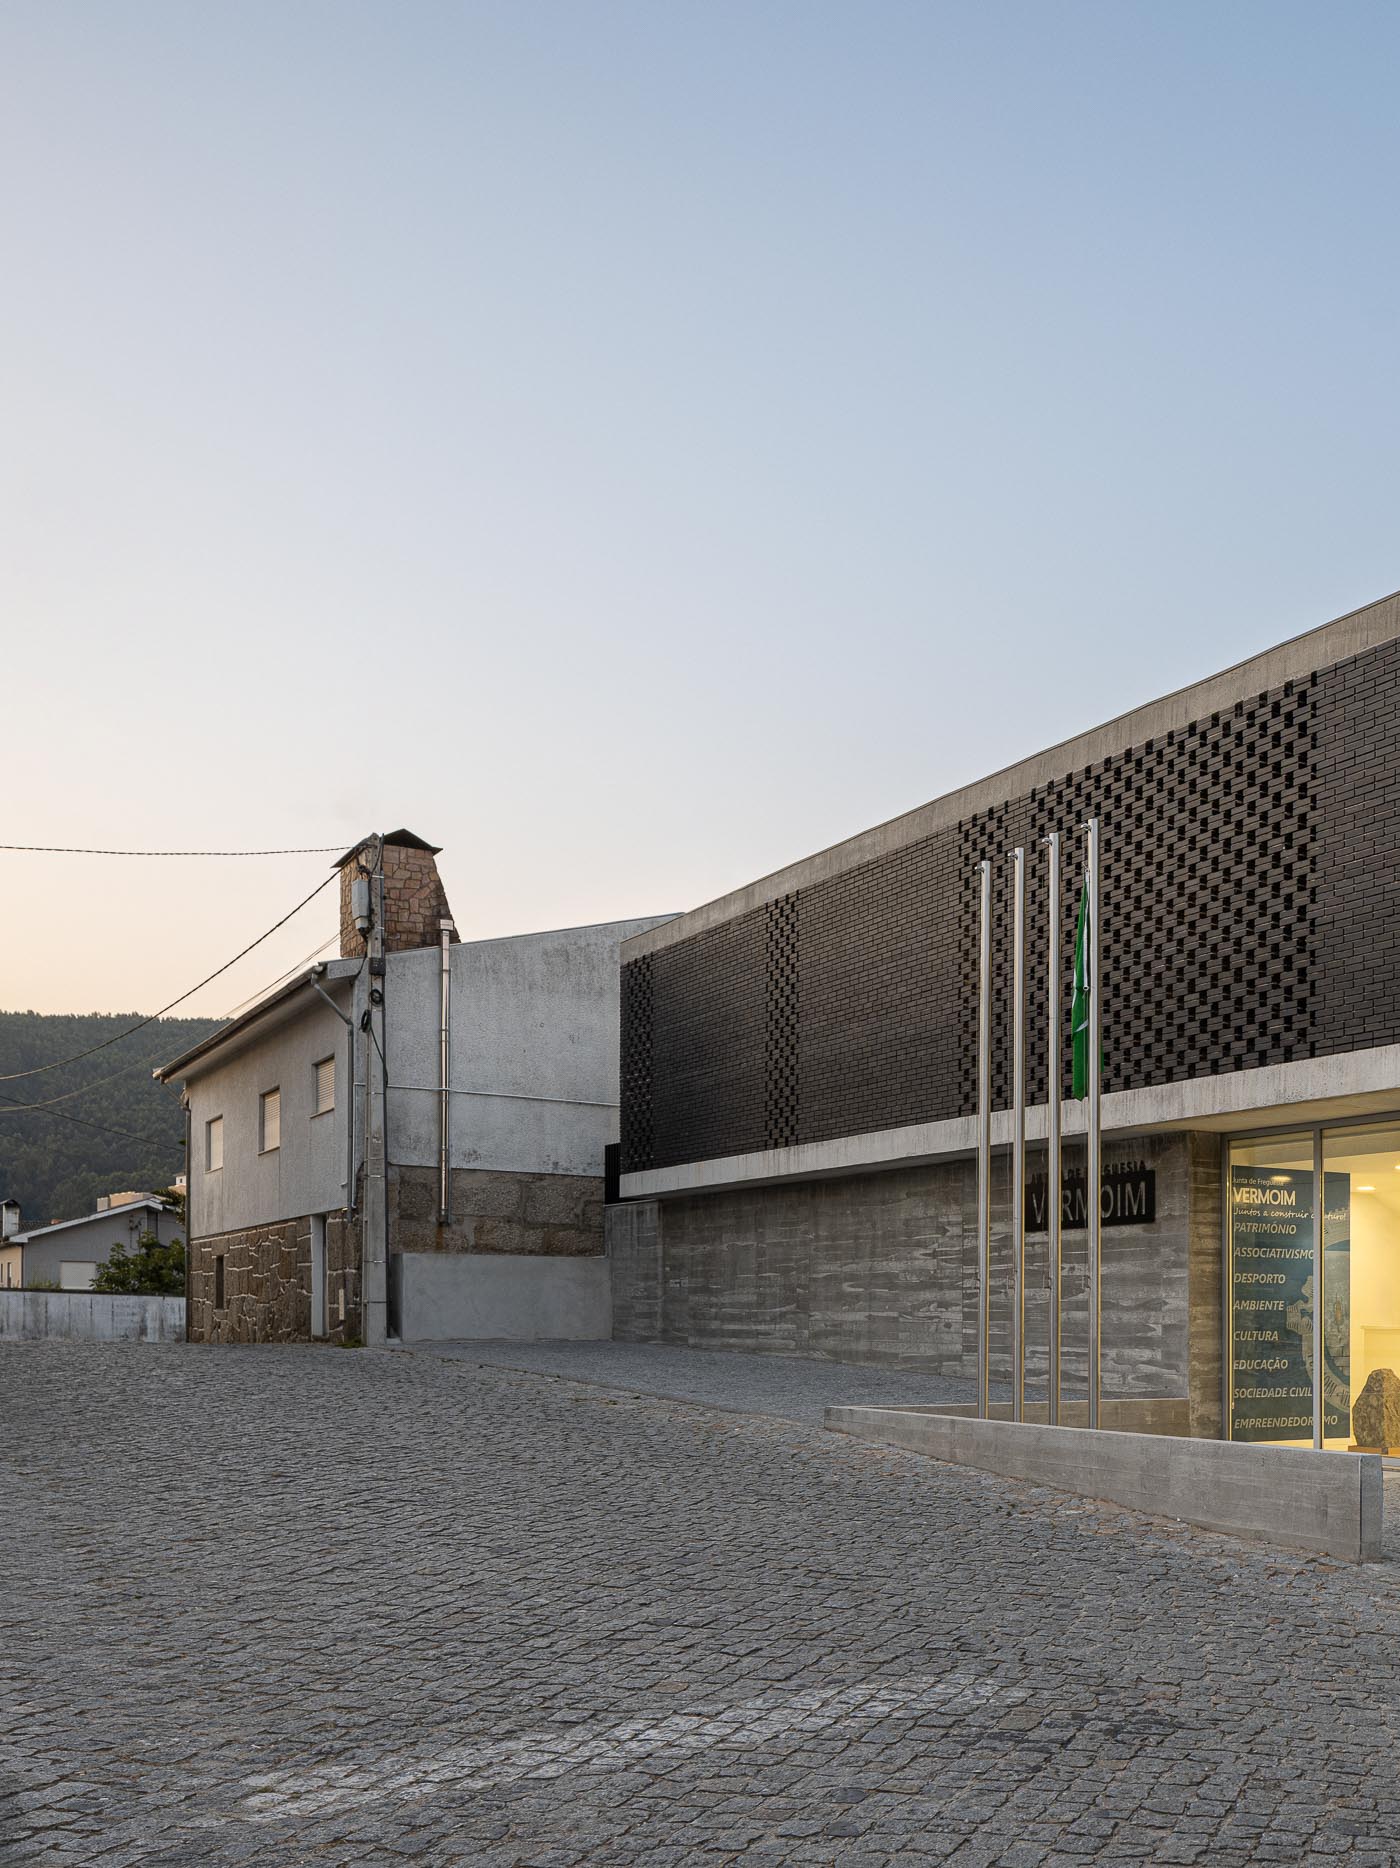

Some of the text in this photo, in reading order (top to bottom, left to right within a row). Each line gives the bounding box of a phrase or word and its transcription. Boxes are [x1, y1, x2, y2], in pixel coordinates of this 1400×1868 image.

[1032, 1181, 1146, 1224] VRMOIM
[1232, 1187, 1296, 1206] VERMOIM
[1233, 1207, 1260, 1217] Juntos
[1270, 1209, 1310, 1219] construir
[1234, 1220, 1297, 1235] PATRIMÓNIO
[1233, 1247, 1314, 1260] ASSOCIATIVISMO
[1234, 1273, 1286, 1284] DESPORTO
[1233, 1300, 1285, 1311] AMBIENTE
[1233, 1331, 1279, 1341] CULTURA
[1233, 1357, 1288, 1372] EDUCAÇÃO
[1234, 1387, 1313, 1398] SOCIEDADE CIVIL
[1234, 1415, 1338, 1429] EMPREENDEDORMO
